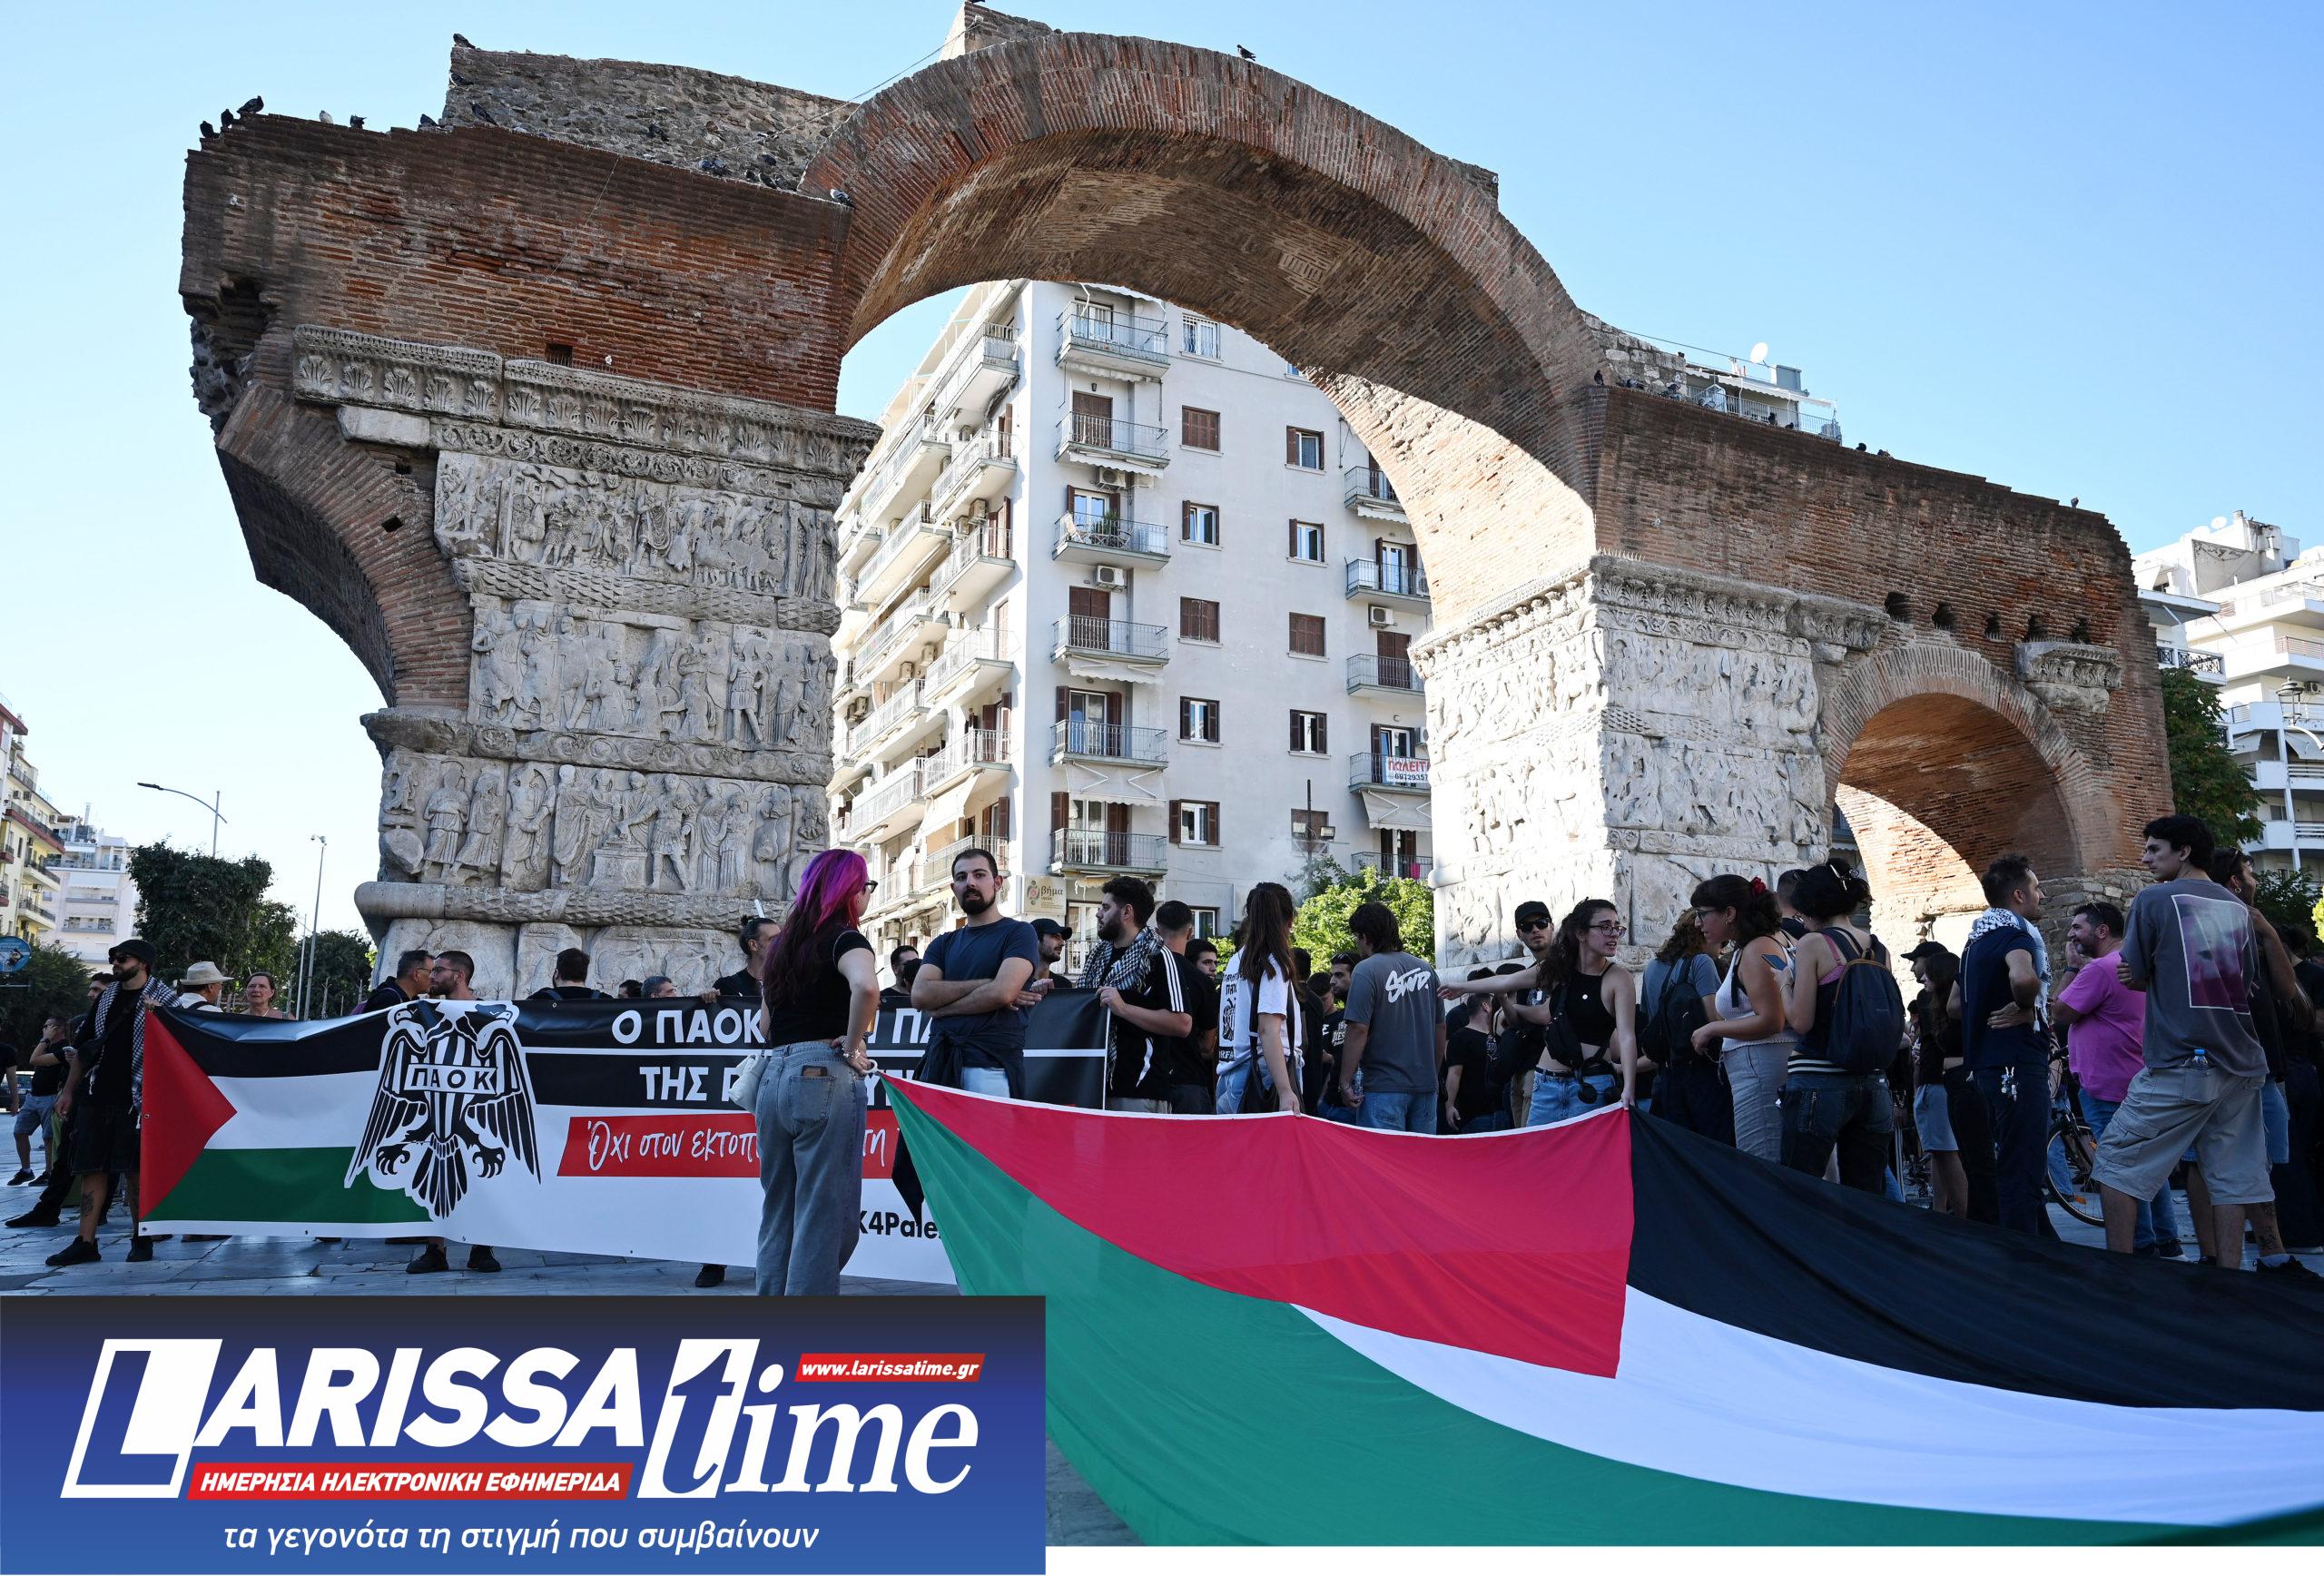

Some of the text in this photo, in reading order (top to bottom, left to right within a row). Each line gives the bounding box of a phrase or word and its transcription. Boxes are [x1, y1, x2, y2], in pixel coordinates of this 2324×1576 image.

[1041, 886, 1063, 896] βήμα
[612, 1010, 642, 1044] Ο
[656, 1009, 767, 1044] ΠΑΟΚ
[411, 1069, 490, 1090] ΠΑΟΚ
[639, 1067, 709, 1101] ΤΗΣ
